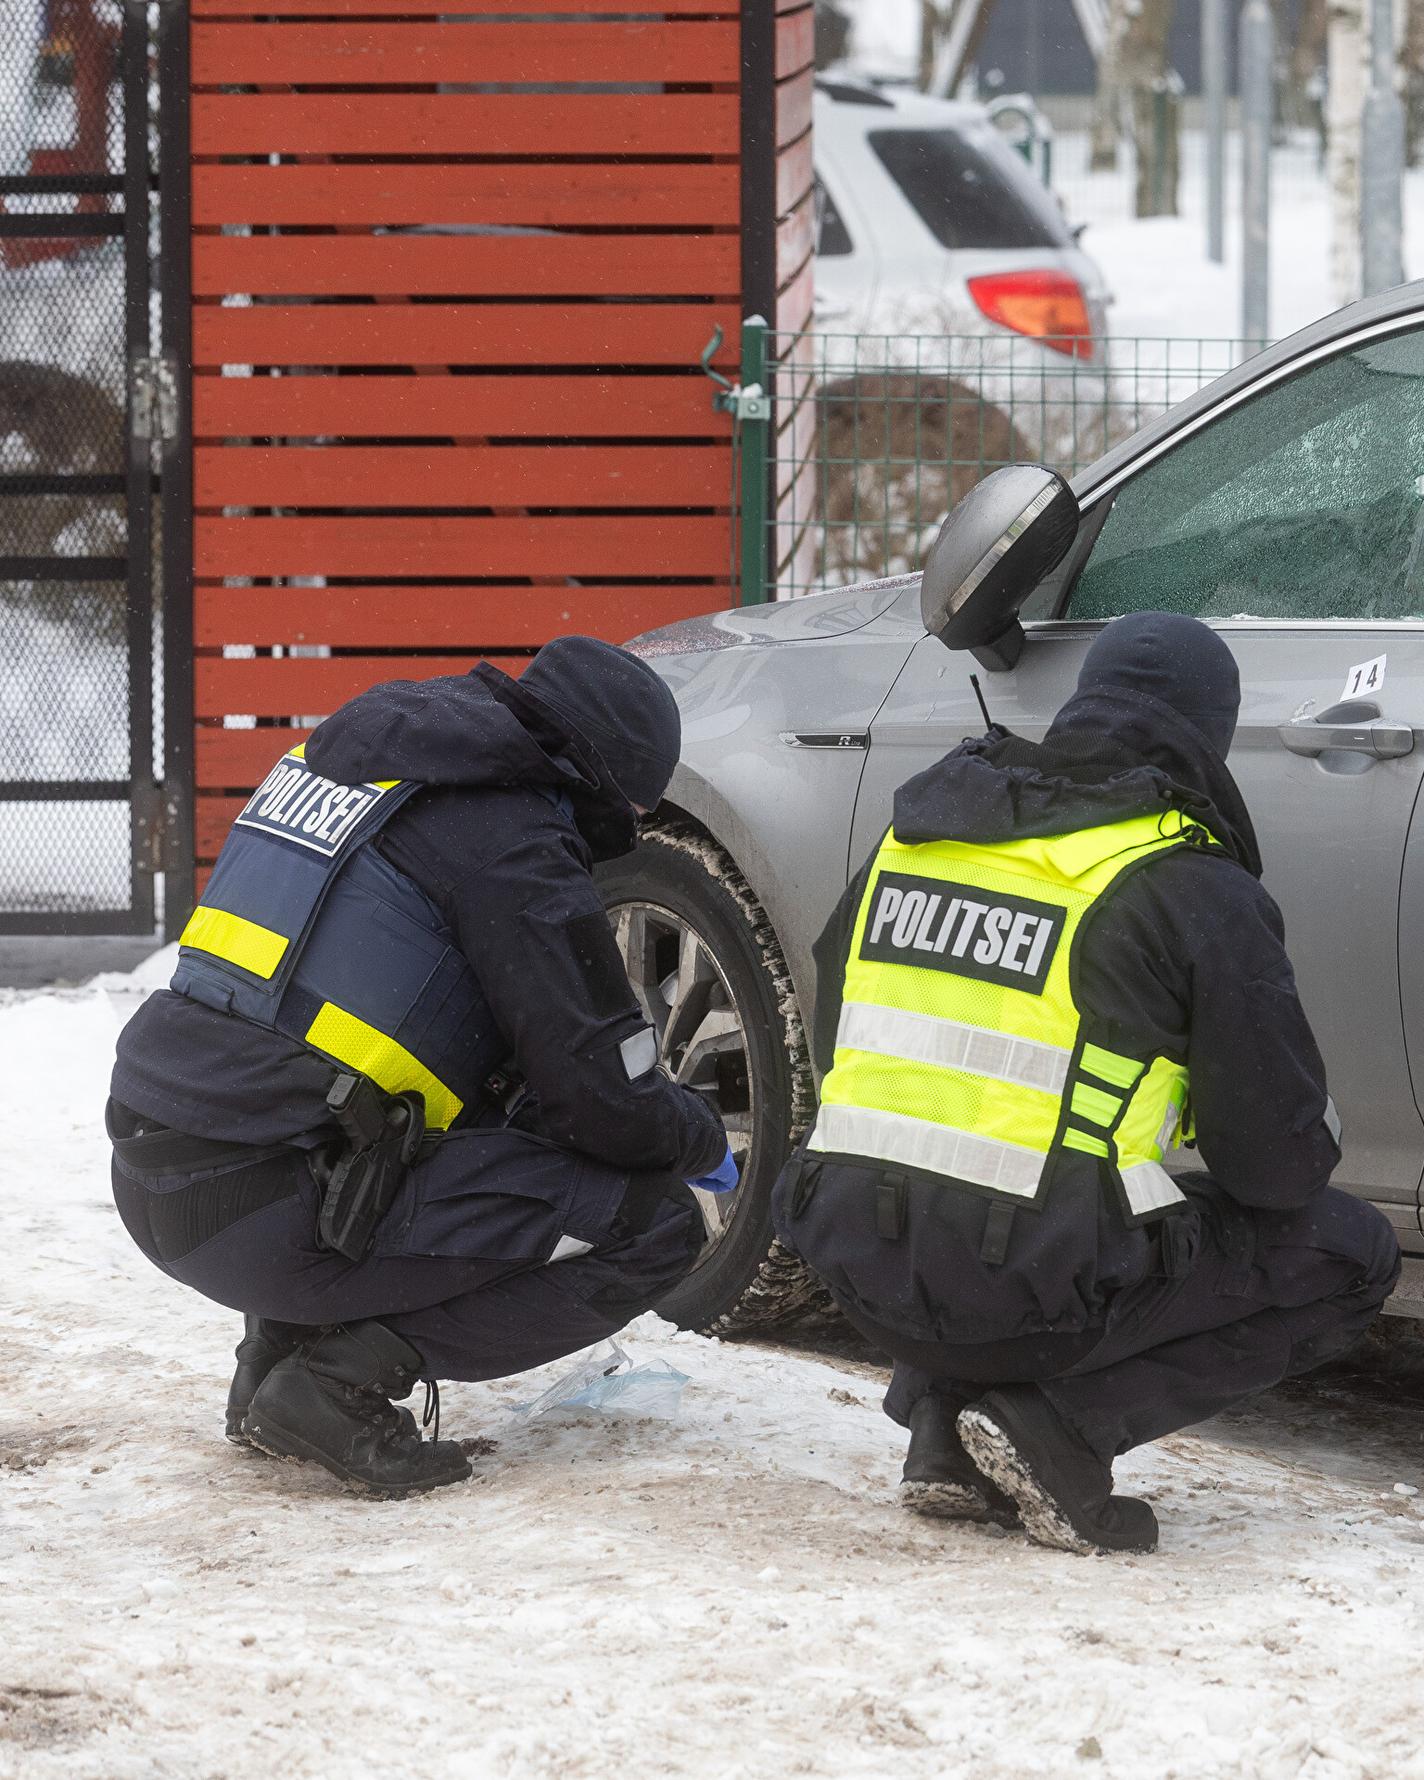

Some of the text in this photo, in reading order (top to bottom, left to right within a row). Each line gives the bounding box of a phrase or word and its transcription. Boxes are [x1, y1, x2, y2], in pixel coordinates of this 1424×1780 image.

[1352, 663, 1378, 694] 14
[245, 763, 375, 846] POLITSEI
[869, 886, 1054, 977] POLITSEI
